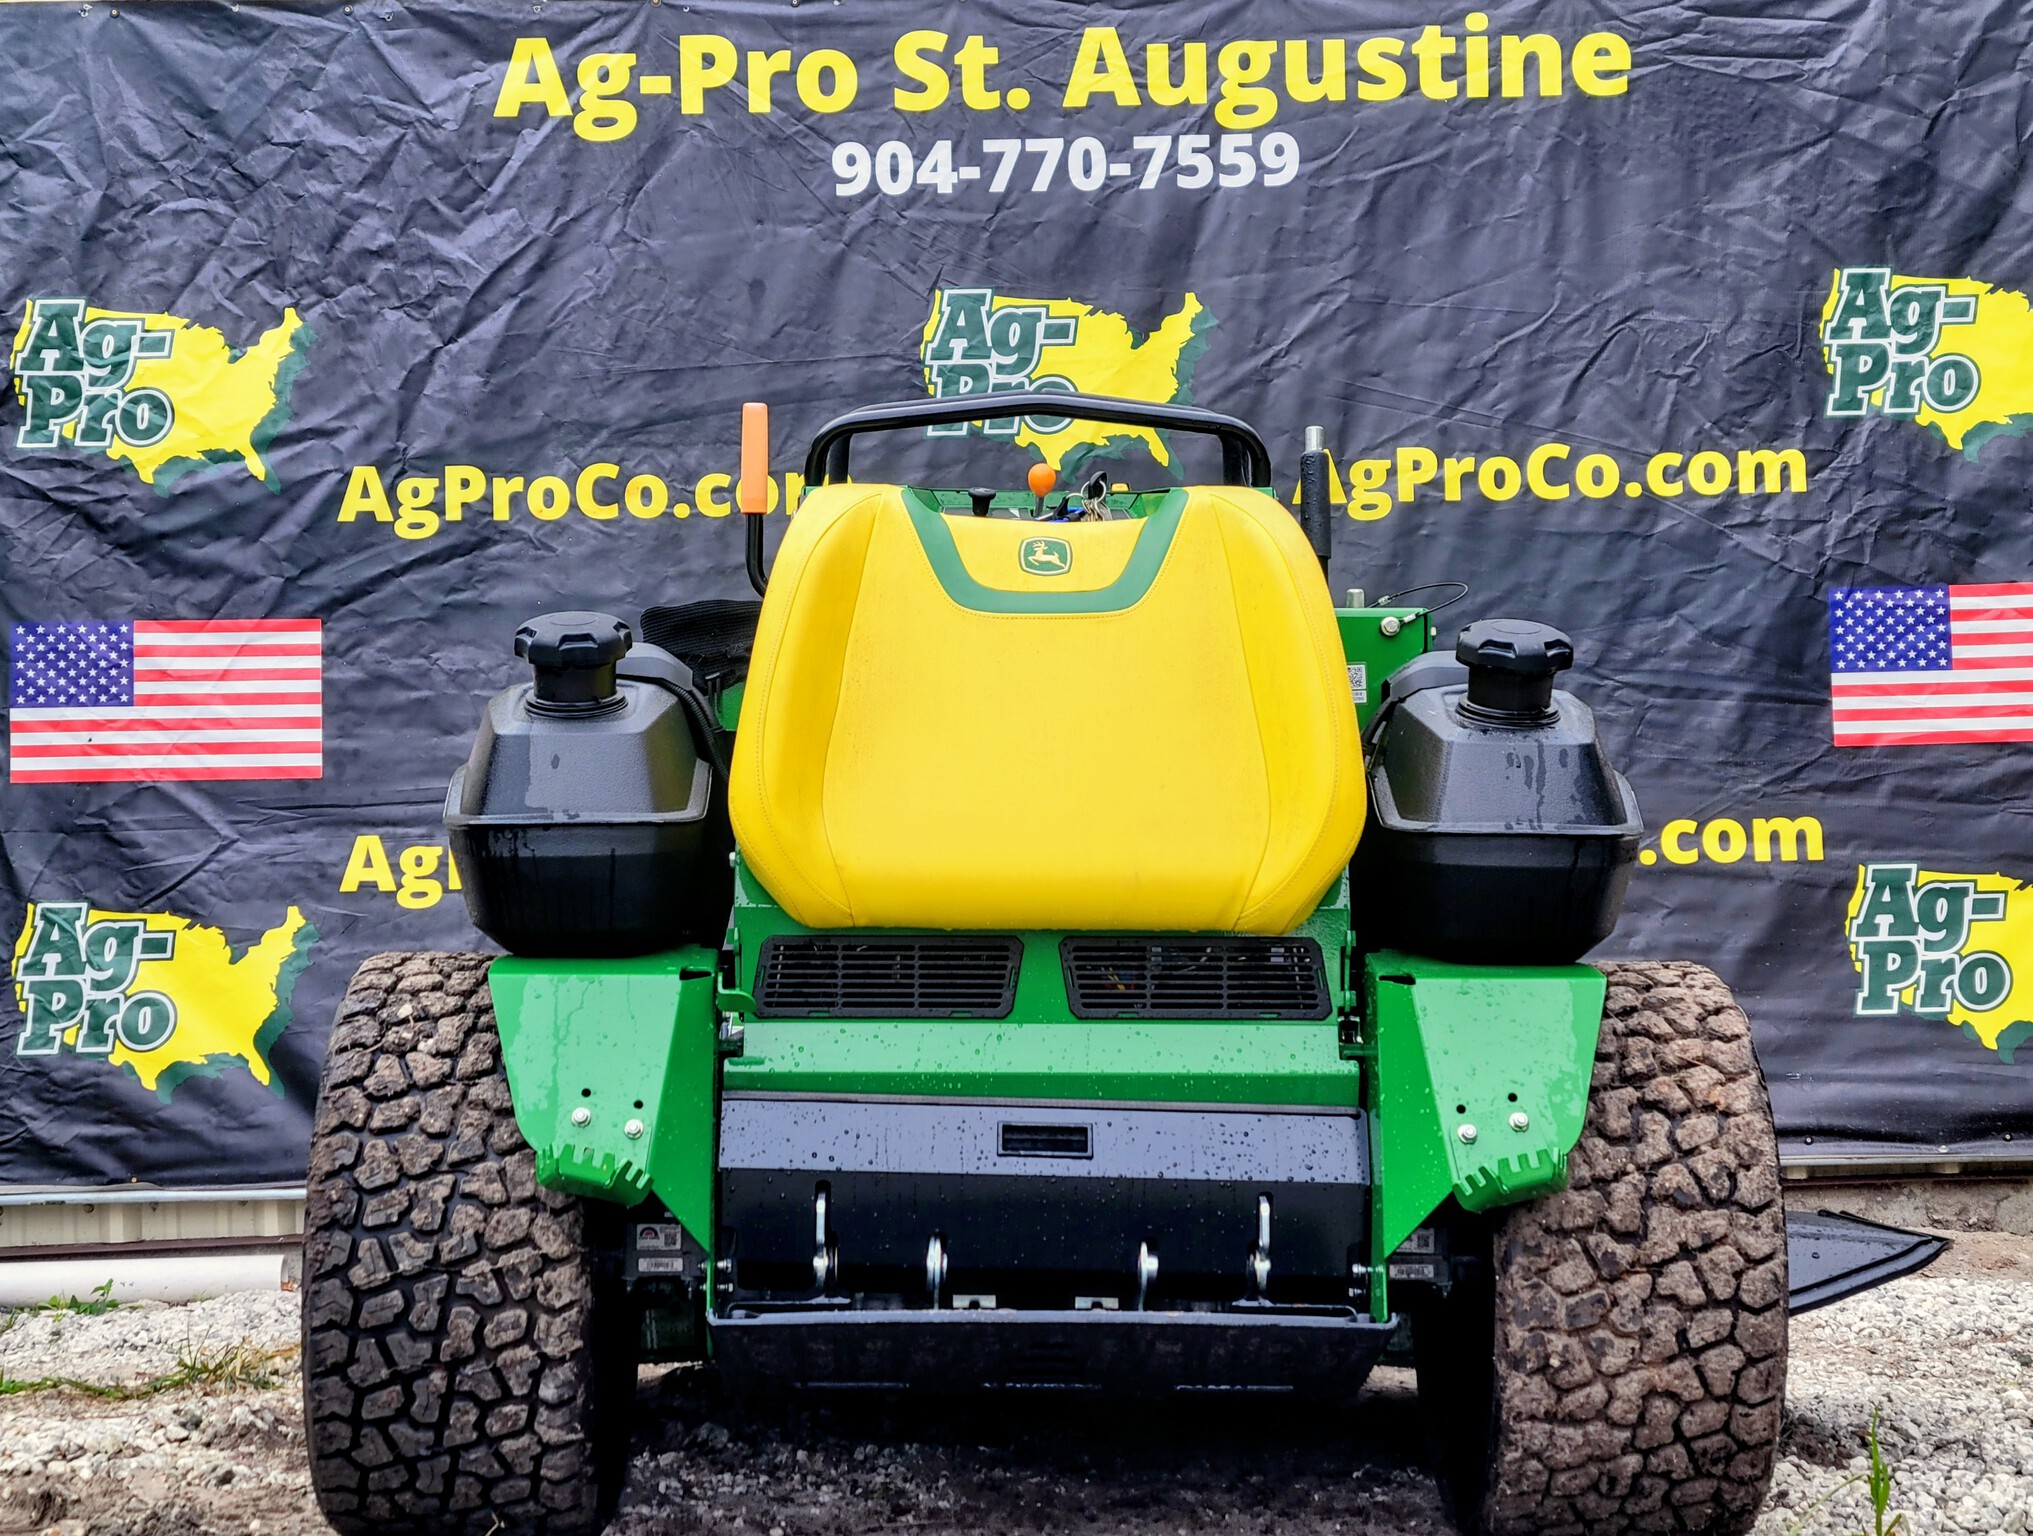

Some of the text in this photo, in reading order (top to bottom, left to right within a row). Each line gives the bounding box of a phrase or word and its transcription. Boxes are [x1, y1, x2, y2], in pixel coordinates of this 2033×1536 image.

[493, 13, 1632, 142] Ag-Pro St. Augustine
[831, 131, 1300, 197] 904-770-7559
[15, 299, 172, 389] Ag-
[925, 288, 1076, 382] Ag-
[1824, 268, 1977, 357] Ag-
[16, 372, 173, 448] Pro
[1827, 340, 1980, 416] Pro
[339, 835, 463, 909] Ag
[1850, 863, 2006, 955] Ag-
[17, 902, 175, 994] Ag-
[1854, 938, 2013, 1016] Pro
[16, 974, 177, 1056] Pro
